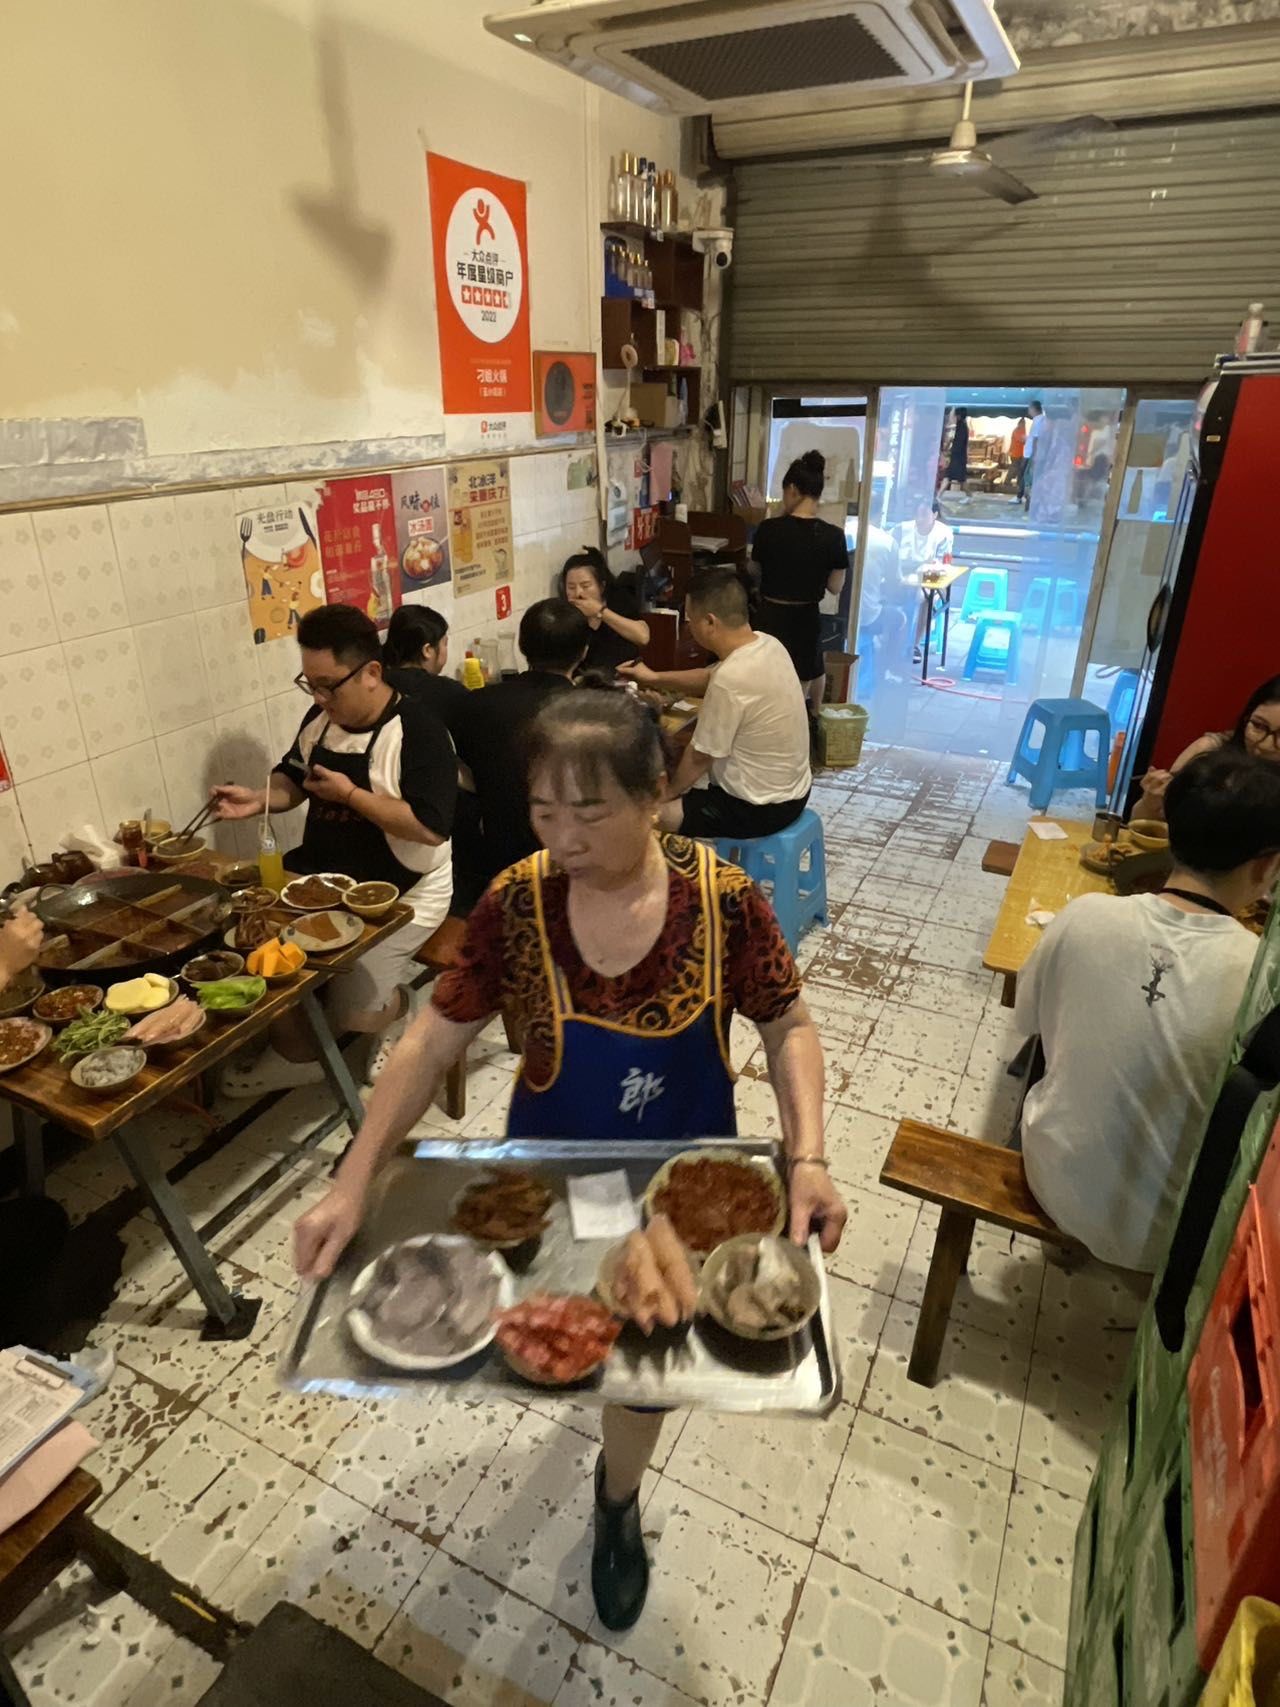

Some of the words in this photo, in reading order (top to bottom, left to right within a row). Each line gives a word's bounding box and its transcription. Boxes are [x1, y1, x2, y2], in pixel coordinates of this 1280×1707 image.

[471, 249, 499, 265] 大众点评
[456, 261, 513, 287] 年度星级商户
[468, 473, 497, 488] 北冰洋
[257, 509, 293, 524] 光盘行动
[500, 594, 507, 612] 3
